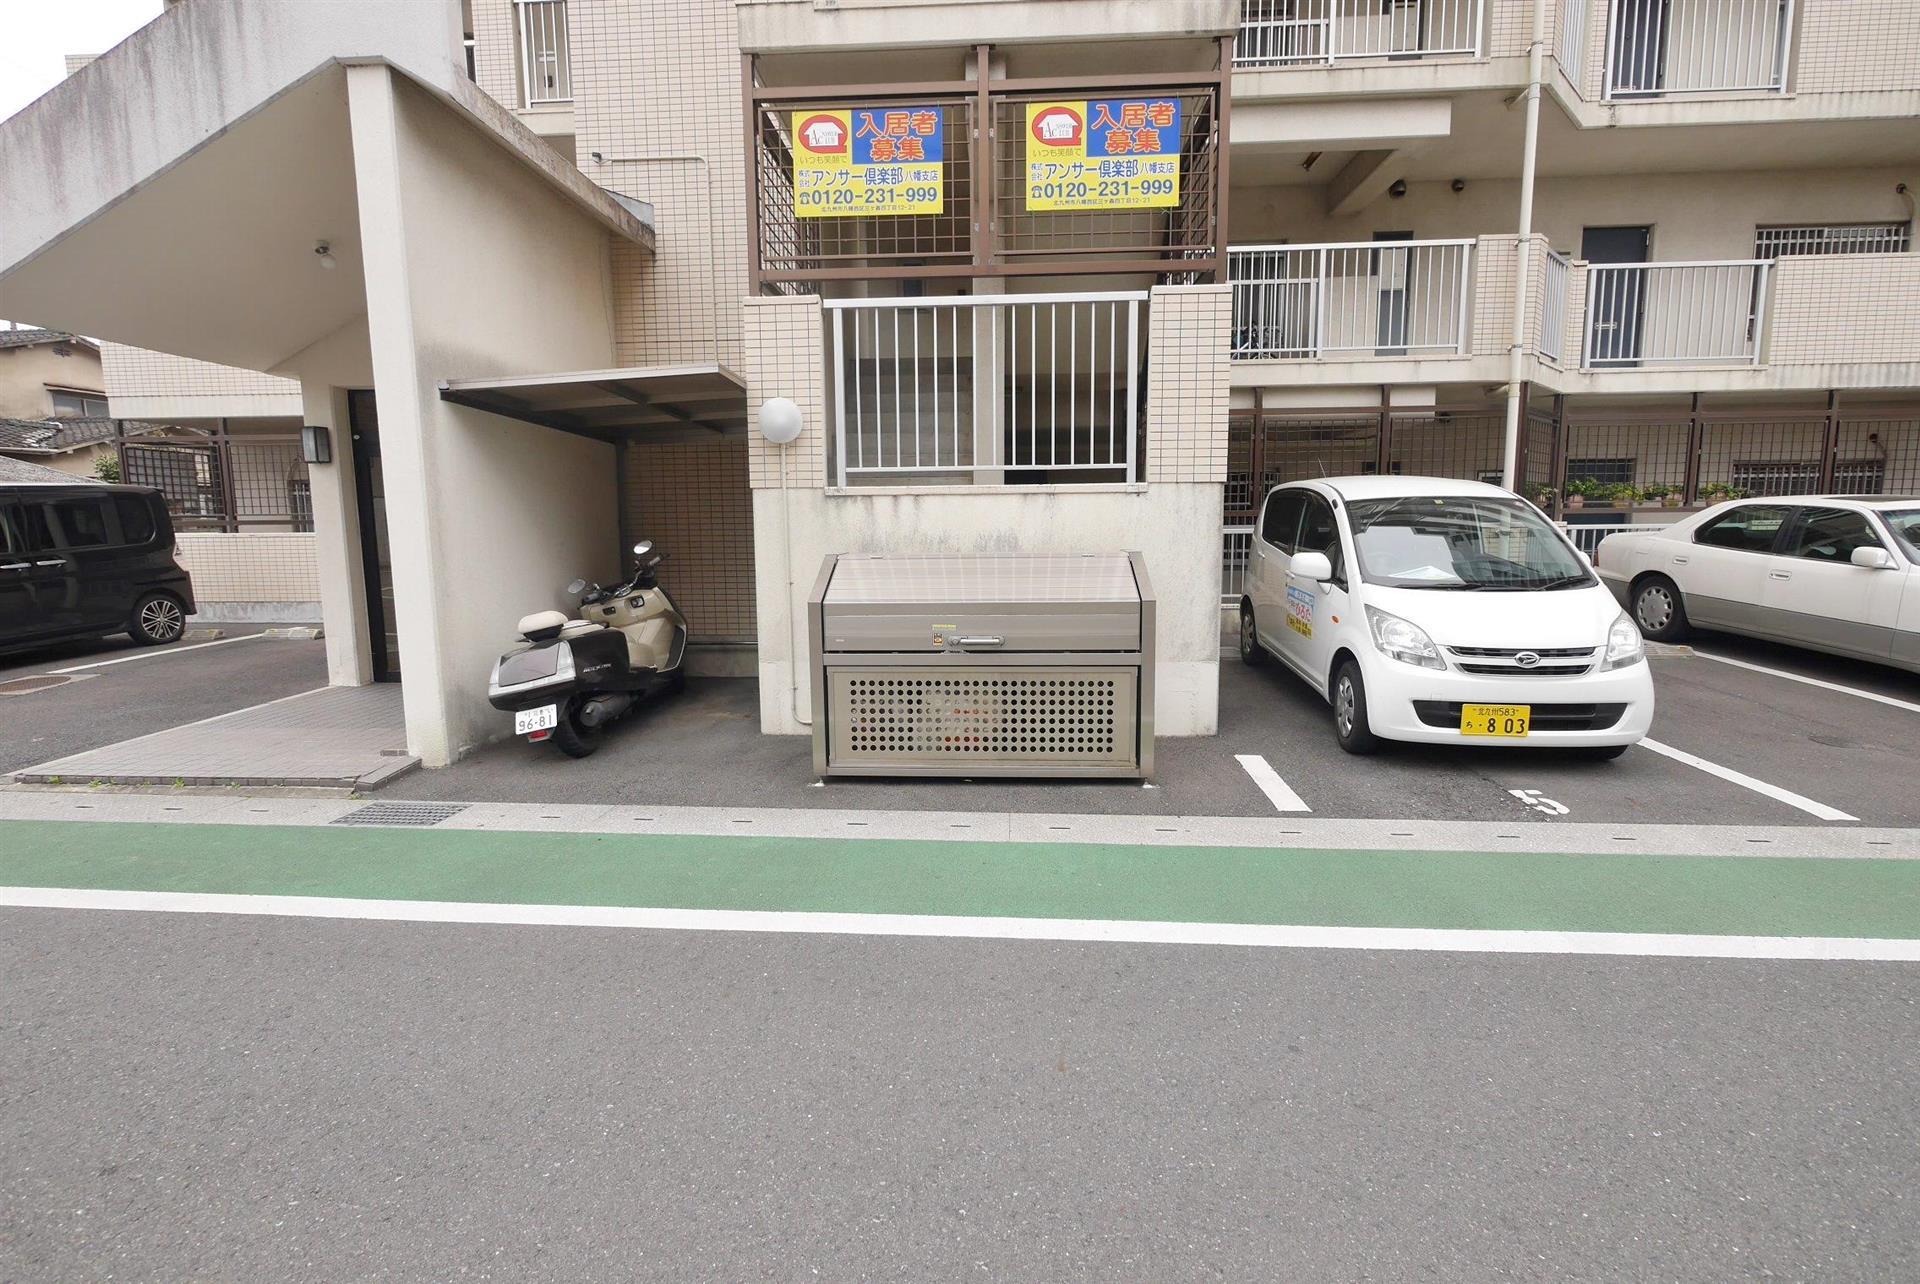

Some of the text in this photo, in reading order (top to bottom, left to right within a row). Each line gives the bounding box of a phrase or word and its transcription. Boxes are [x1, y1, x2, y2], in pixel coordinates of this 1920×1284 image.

[856, 111, 938, 138] 入居者
[1091, 102, 1175, 130] 入居者
[870, 135, 924, 162] 募集
[1033, 148, 1081, 156] いつも笑顔で
[1105, 128, 1160, 154] 募集
[800, 156, 847, 164] いつも笑顔で
[812, 187, 937, 204] 0120-231-999
[1044, 179, 1173, 197] 0120-231-999
